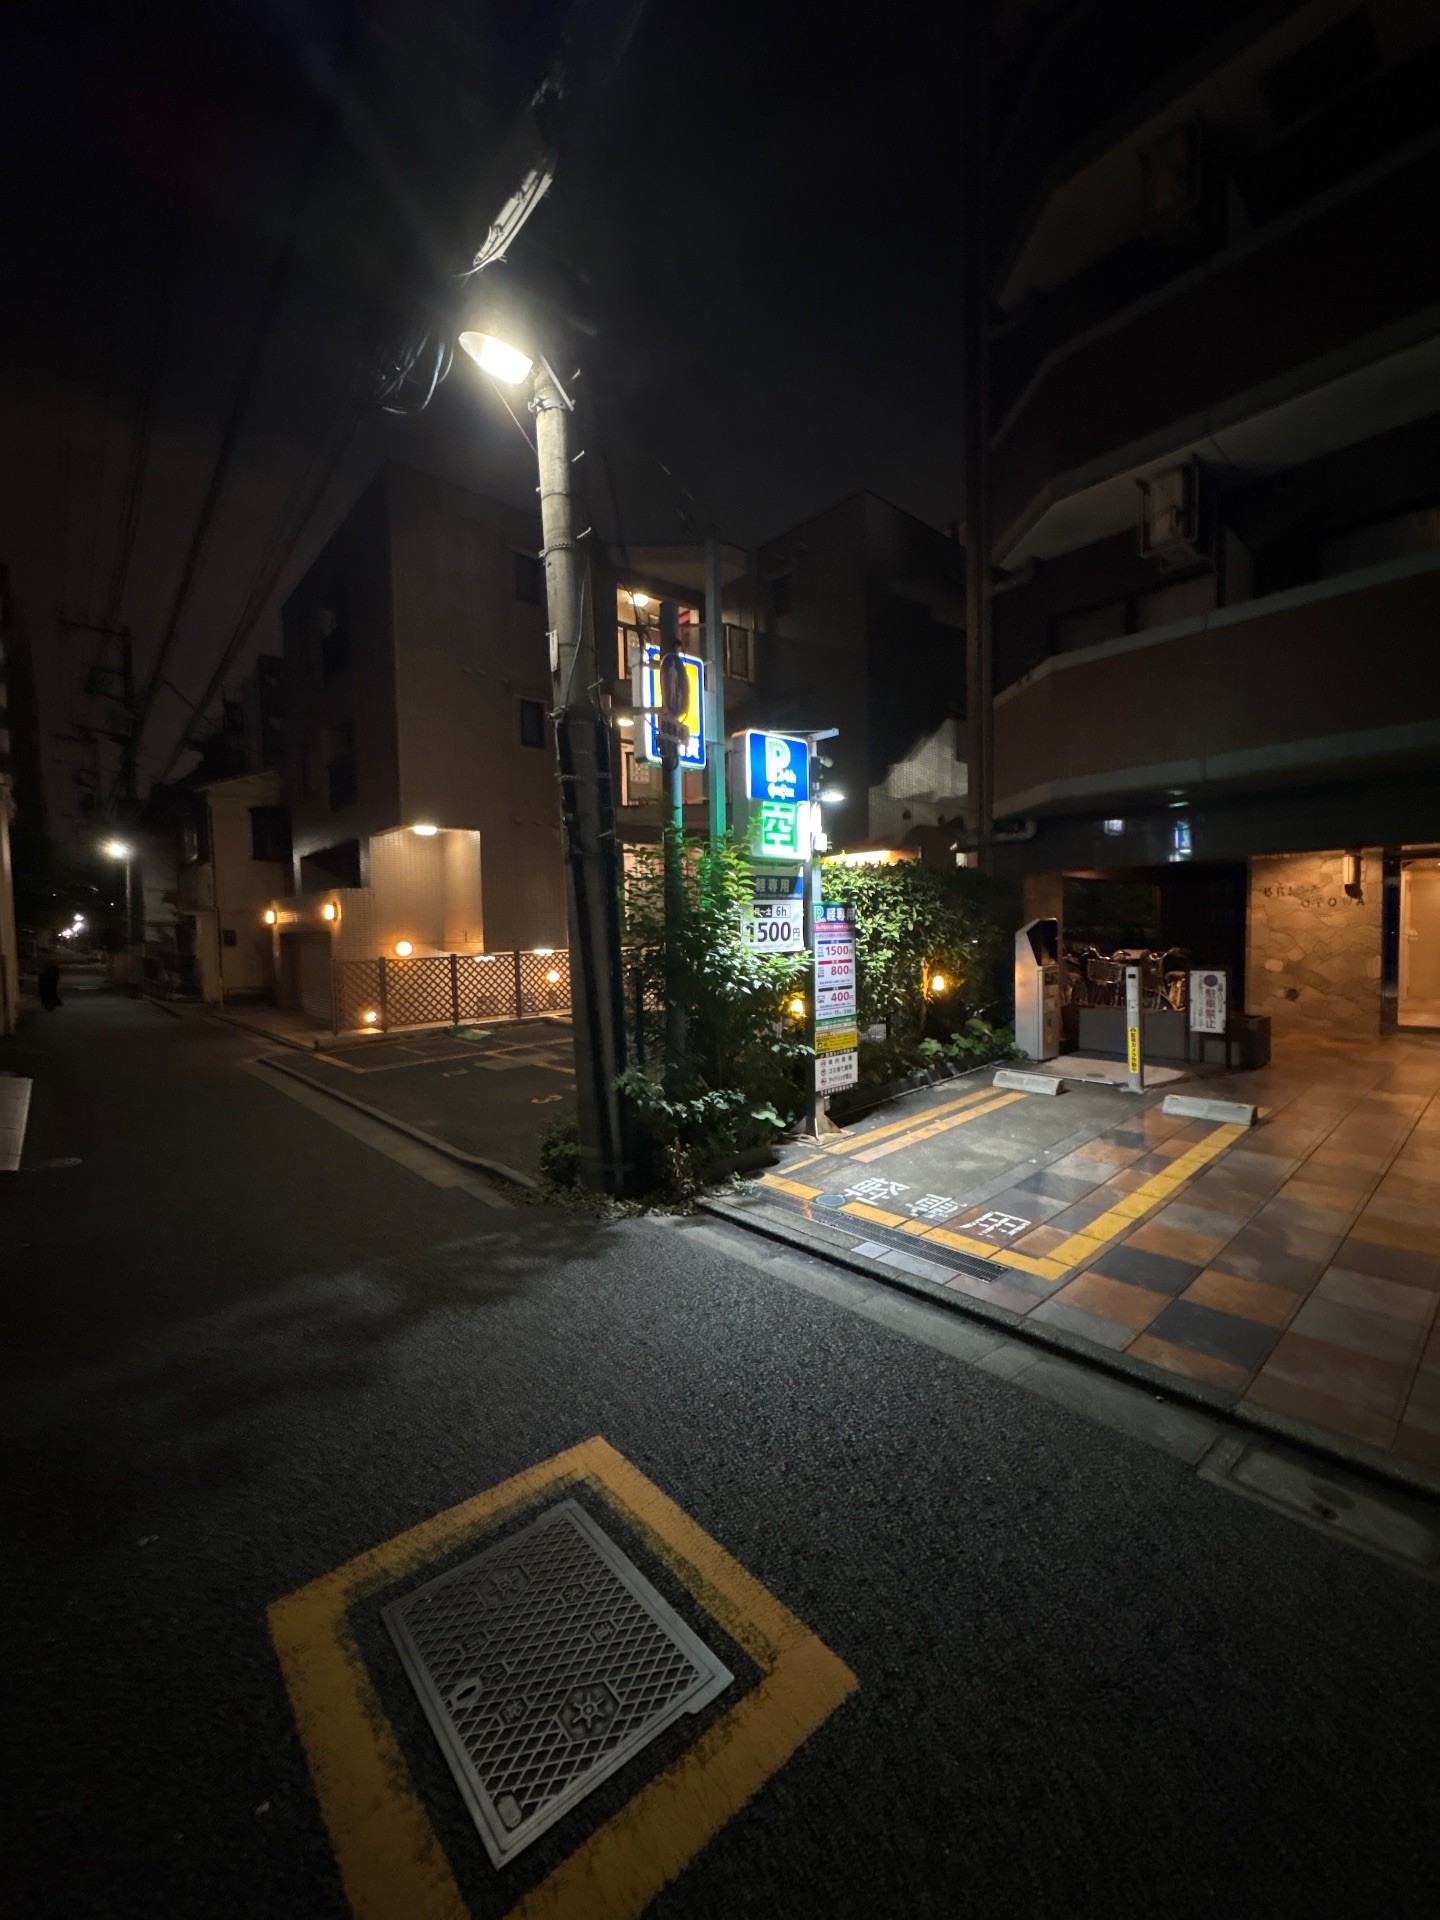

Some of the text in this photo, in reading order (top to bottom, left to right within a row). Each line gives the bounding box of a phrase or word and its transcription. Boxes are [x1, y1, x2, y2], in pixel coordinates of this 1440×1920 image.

[765, 736, 791, 782] P
[763, 803, 795, 849] 空
[755, 878, 790, 893] 軽専用
[776, 906, 787, 917] 6h
[843, 1177, 1032, 1239] 軽専用
